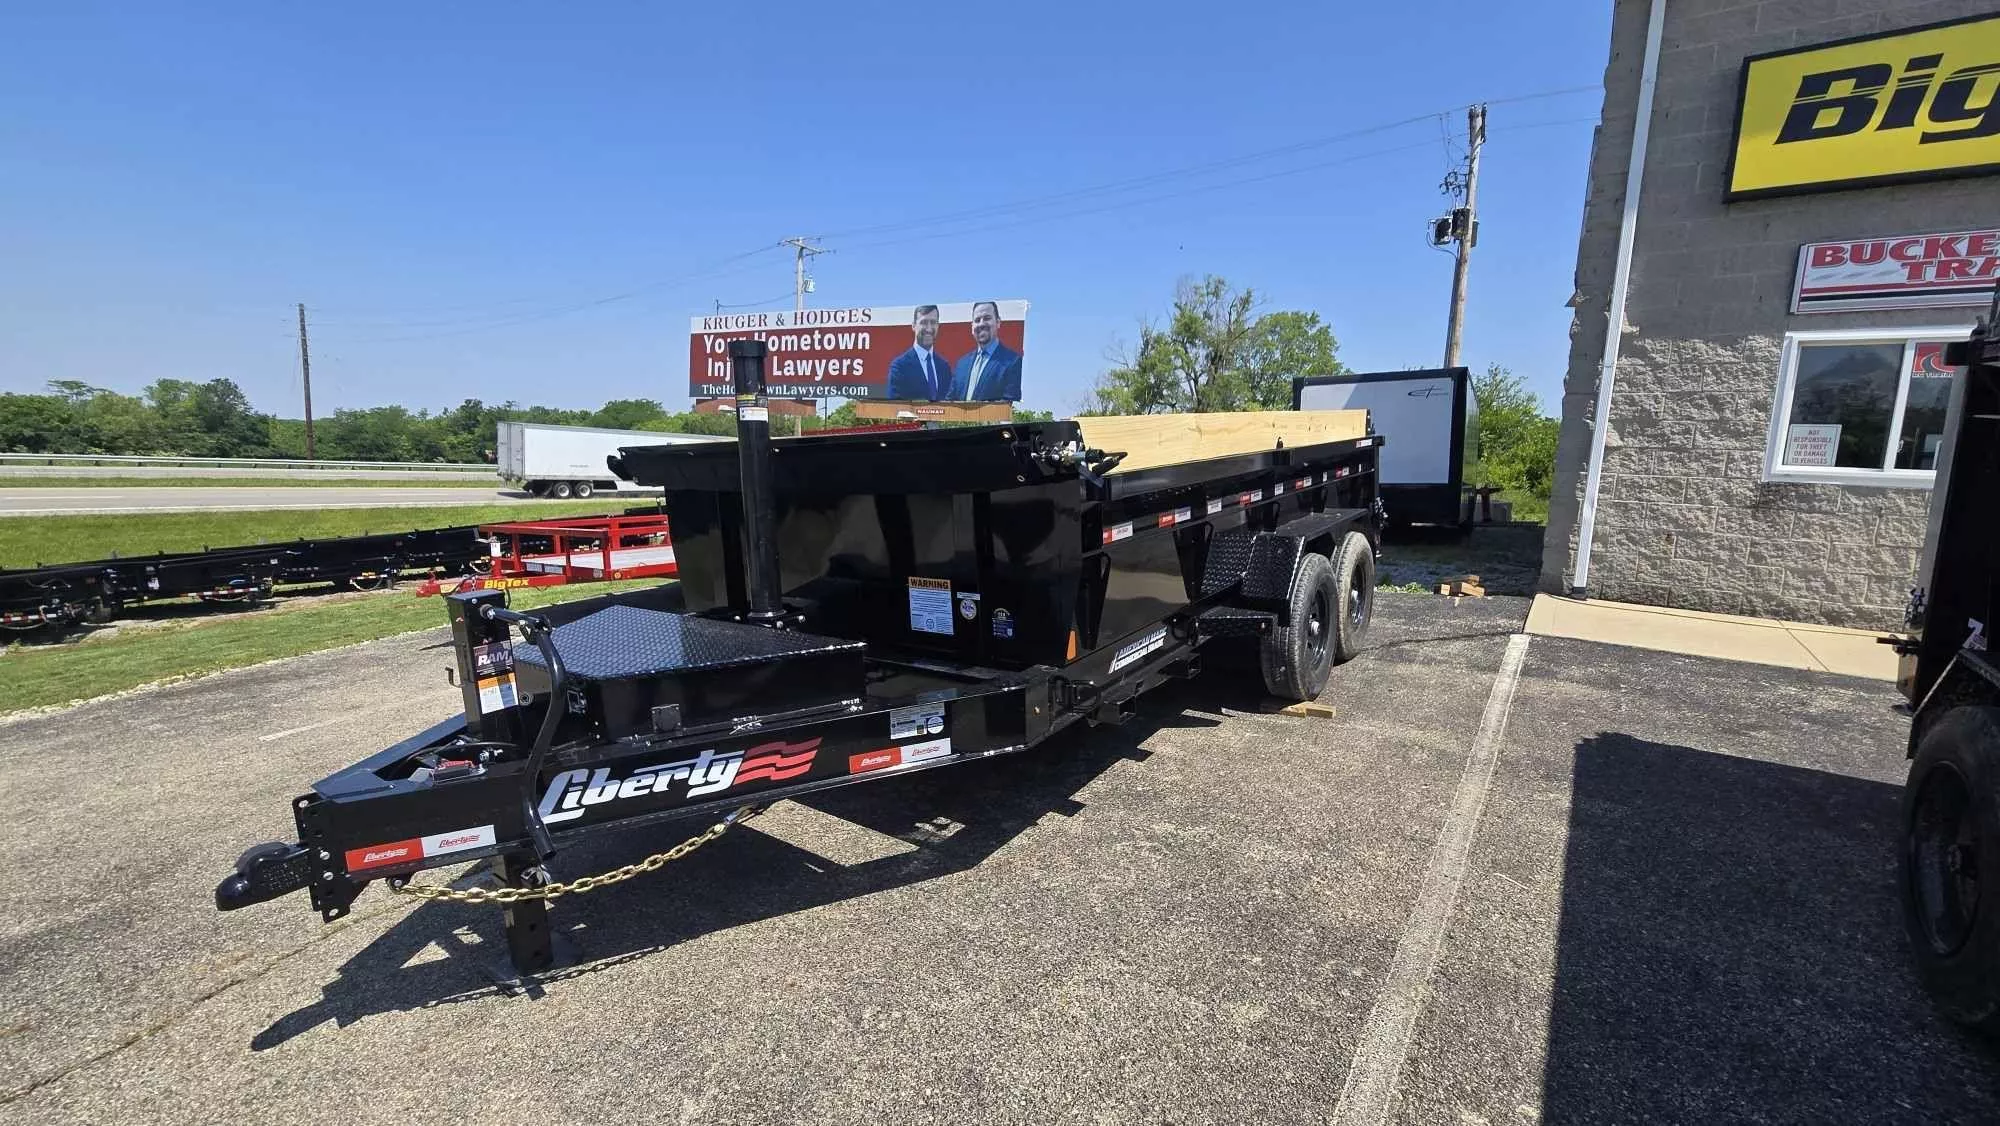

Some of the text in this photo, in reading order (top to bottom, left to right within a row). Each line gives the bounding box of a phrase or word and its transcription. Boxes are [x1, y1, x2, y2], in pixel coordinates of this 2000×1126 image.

[1774, 53, 2000, 145] Big
[703, 308, 872, 330] KRUGER & HODGES
[703, 334, 747, 354] Yo
[772, 355, 864, 382] Lawyers
[910, 579, 950, 589] WARNING
[477, 650, 509, 666] RAM
[538, 749, 745, 825] Liberty
[438, 835, 472, 849] Liberty
[363, 848, 400, 863] Liberty
